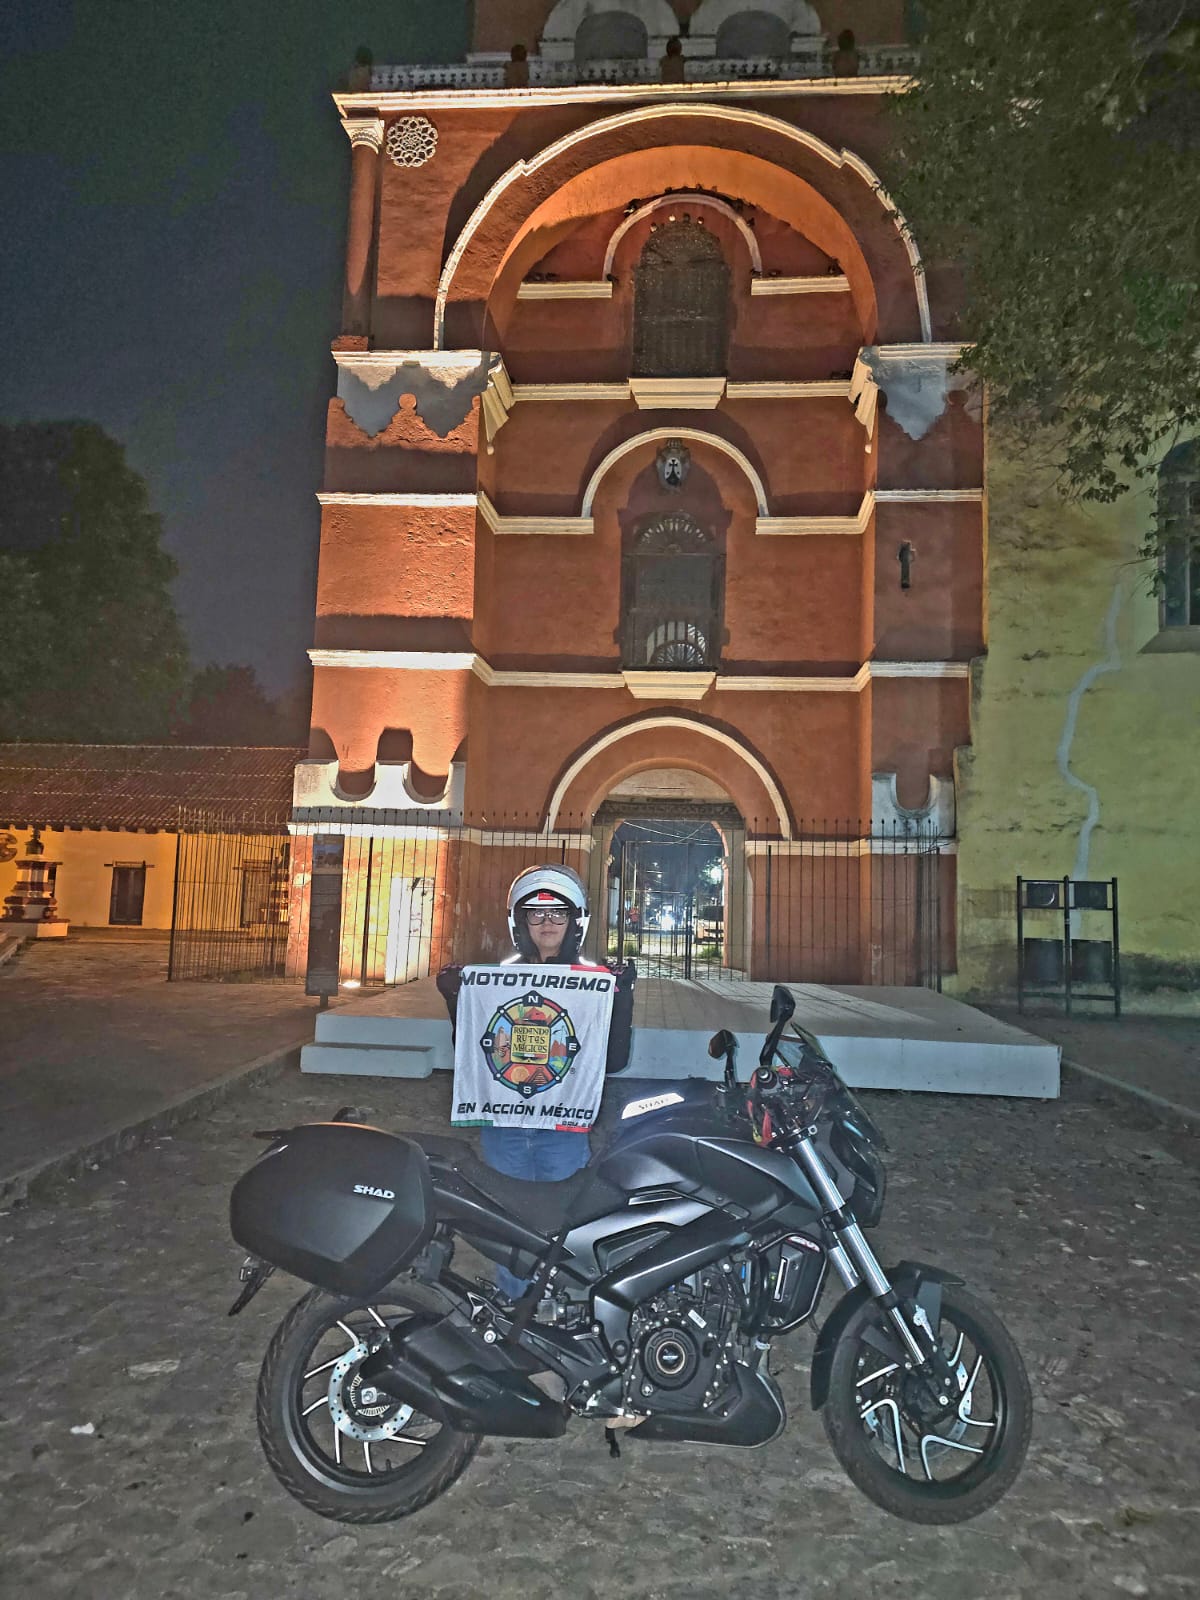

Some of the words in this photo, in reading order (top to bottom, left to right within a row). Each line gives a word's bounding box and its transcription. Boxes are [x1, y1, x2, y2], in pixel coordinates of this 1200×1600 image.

[461, 971, 611, 993] MOTOTURISMO
[528, 995, 539, 1003] N
[482, 1038, 493, 1046] O
[568, 1042, 577, 1051] E
[523, 1086, 532, 1094] S
[457, 1102, 476, 1114] EN
[481, 1101, 535, 1116] ACCIÓN
[540, 1102, 594, 1120] MÉXICO
[353, 1184, 395, 1199] SHAD
